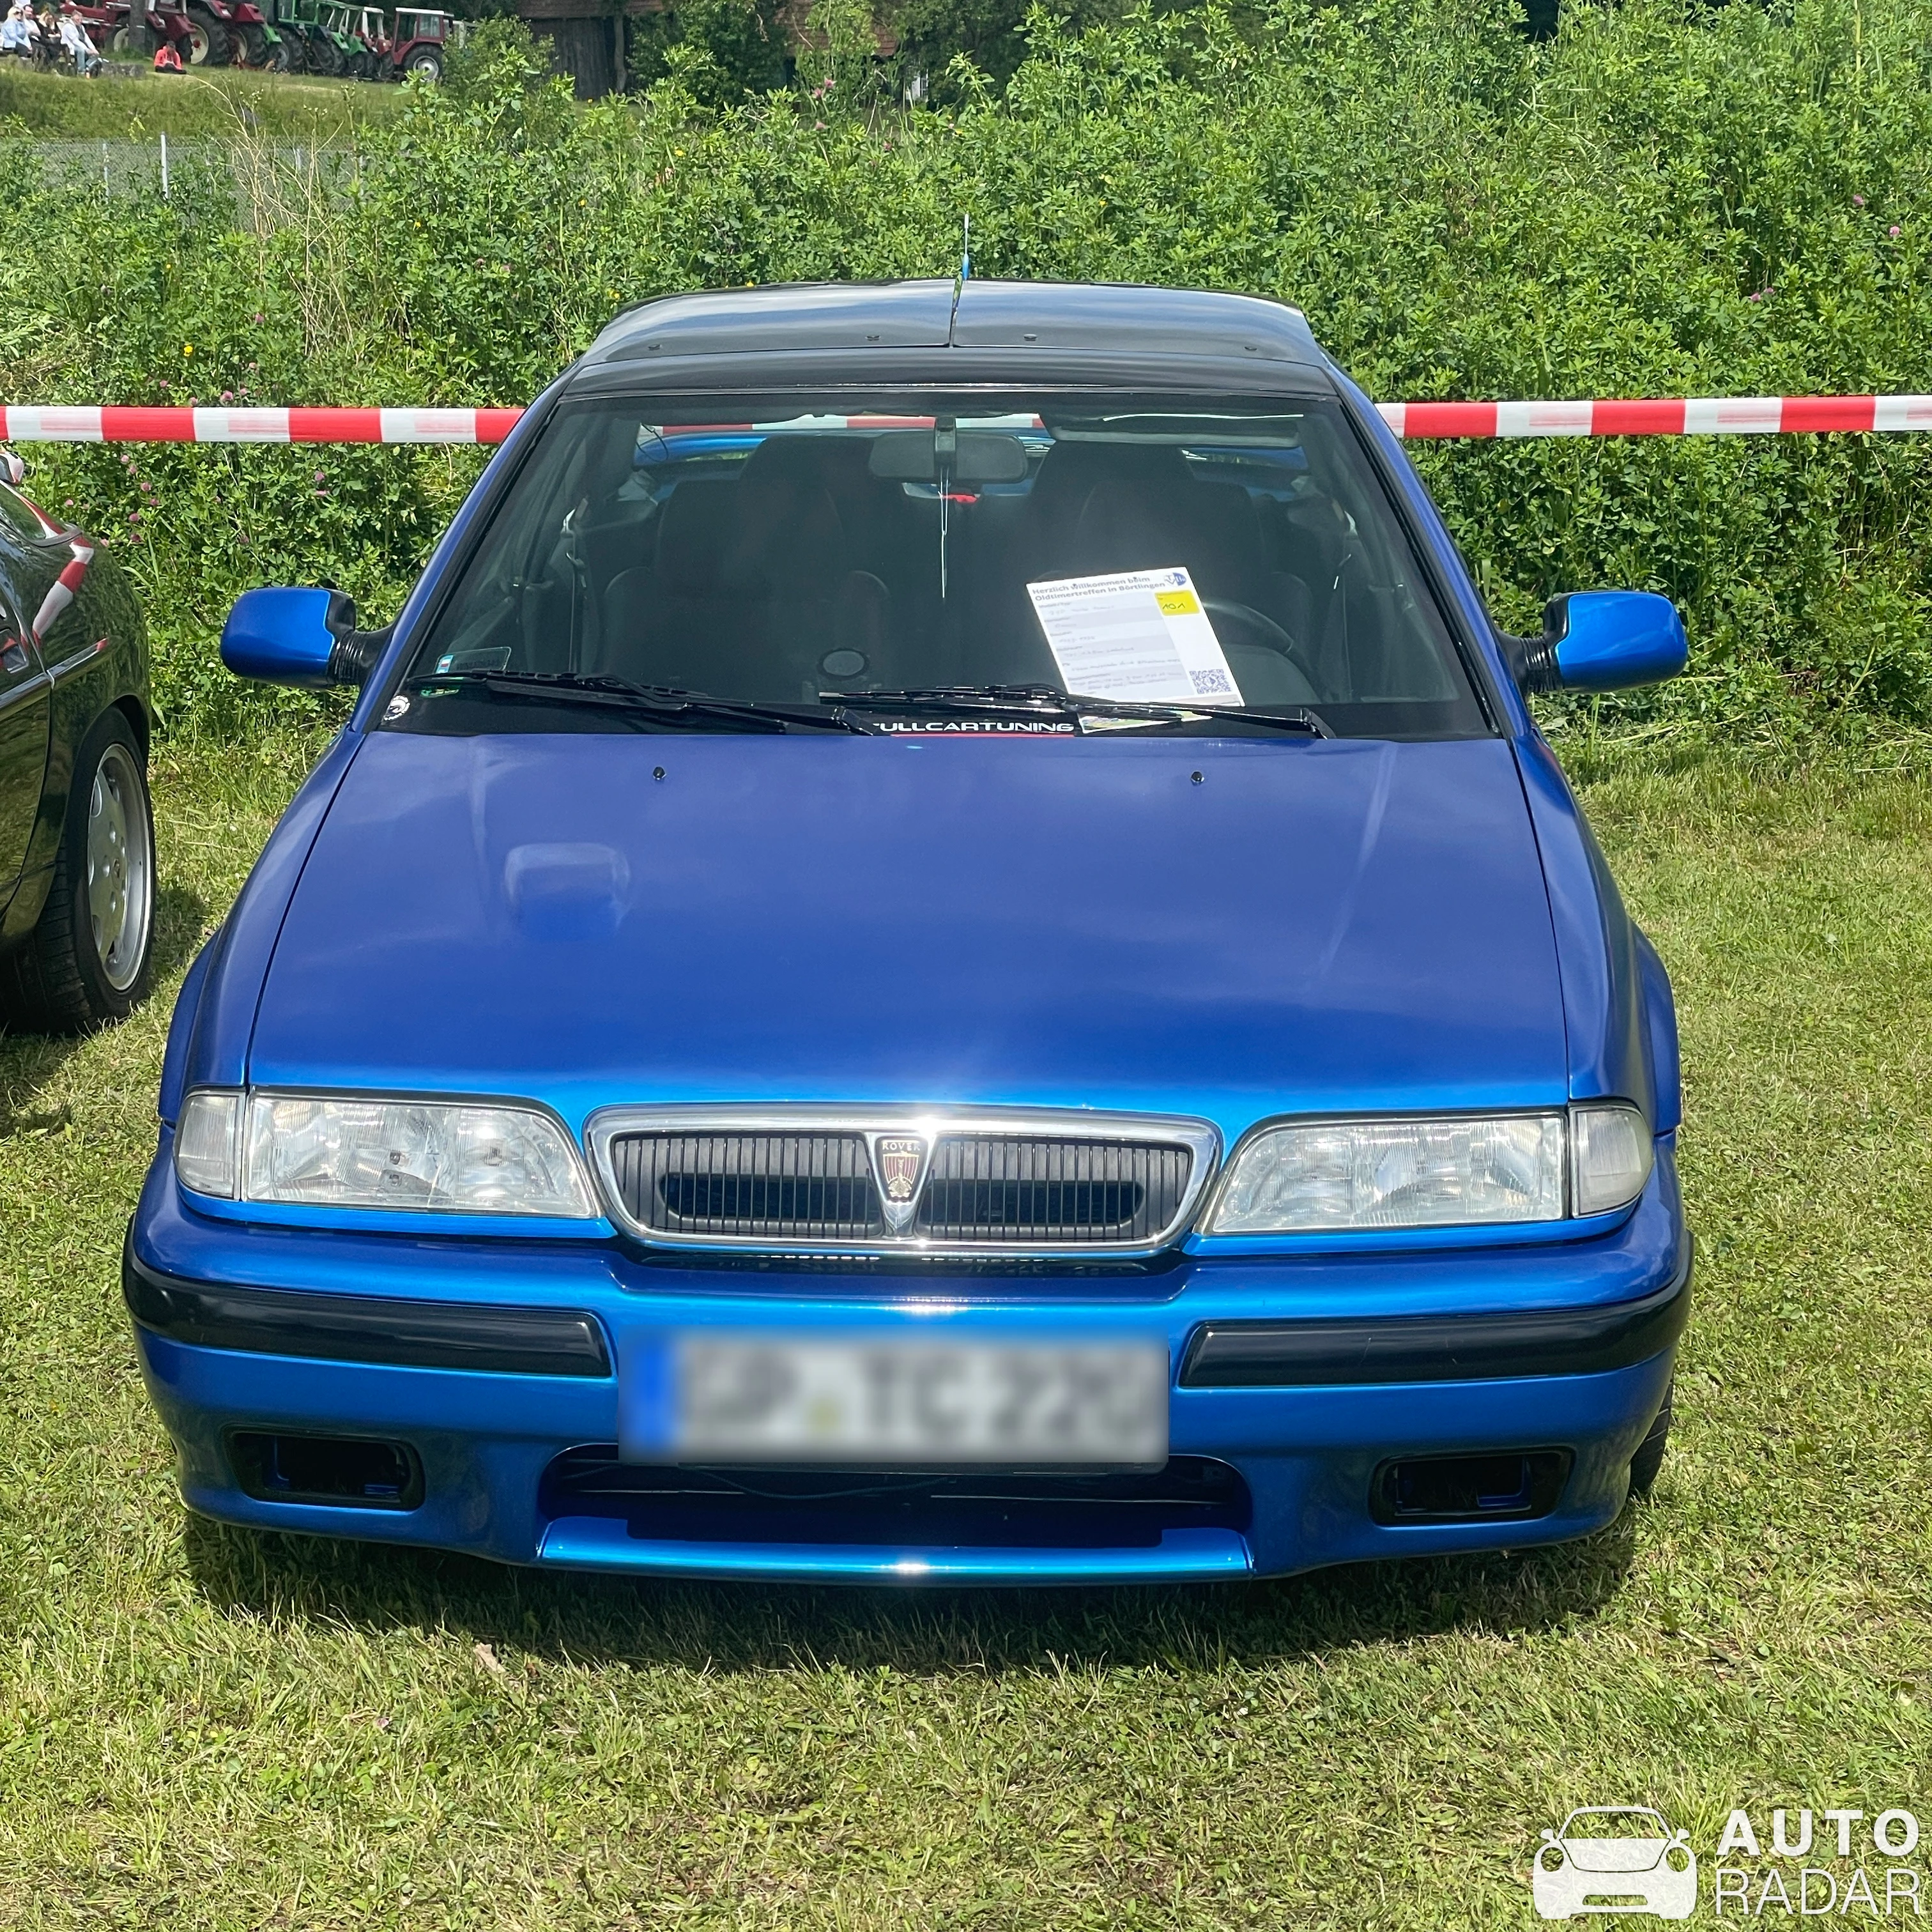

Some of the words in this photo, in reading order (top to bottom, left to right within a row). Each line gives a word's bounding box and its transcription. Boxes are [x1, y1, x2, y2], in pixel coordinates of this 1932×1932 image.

[1032, 584, 1070, 595] Herzlich
[1070, 579, 1126, 589] willkommen
[1035, 587, 1107, 601] Oldtimertreffen
[1118, 582, 1165, 592] Börtlingen
[873, 722, 1075, 732] ULLCARTUNING
[882, 1142, 921, 1151] ROVER
